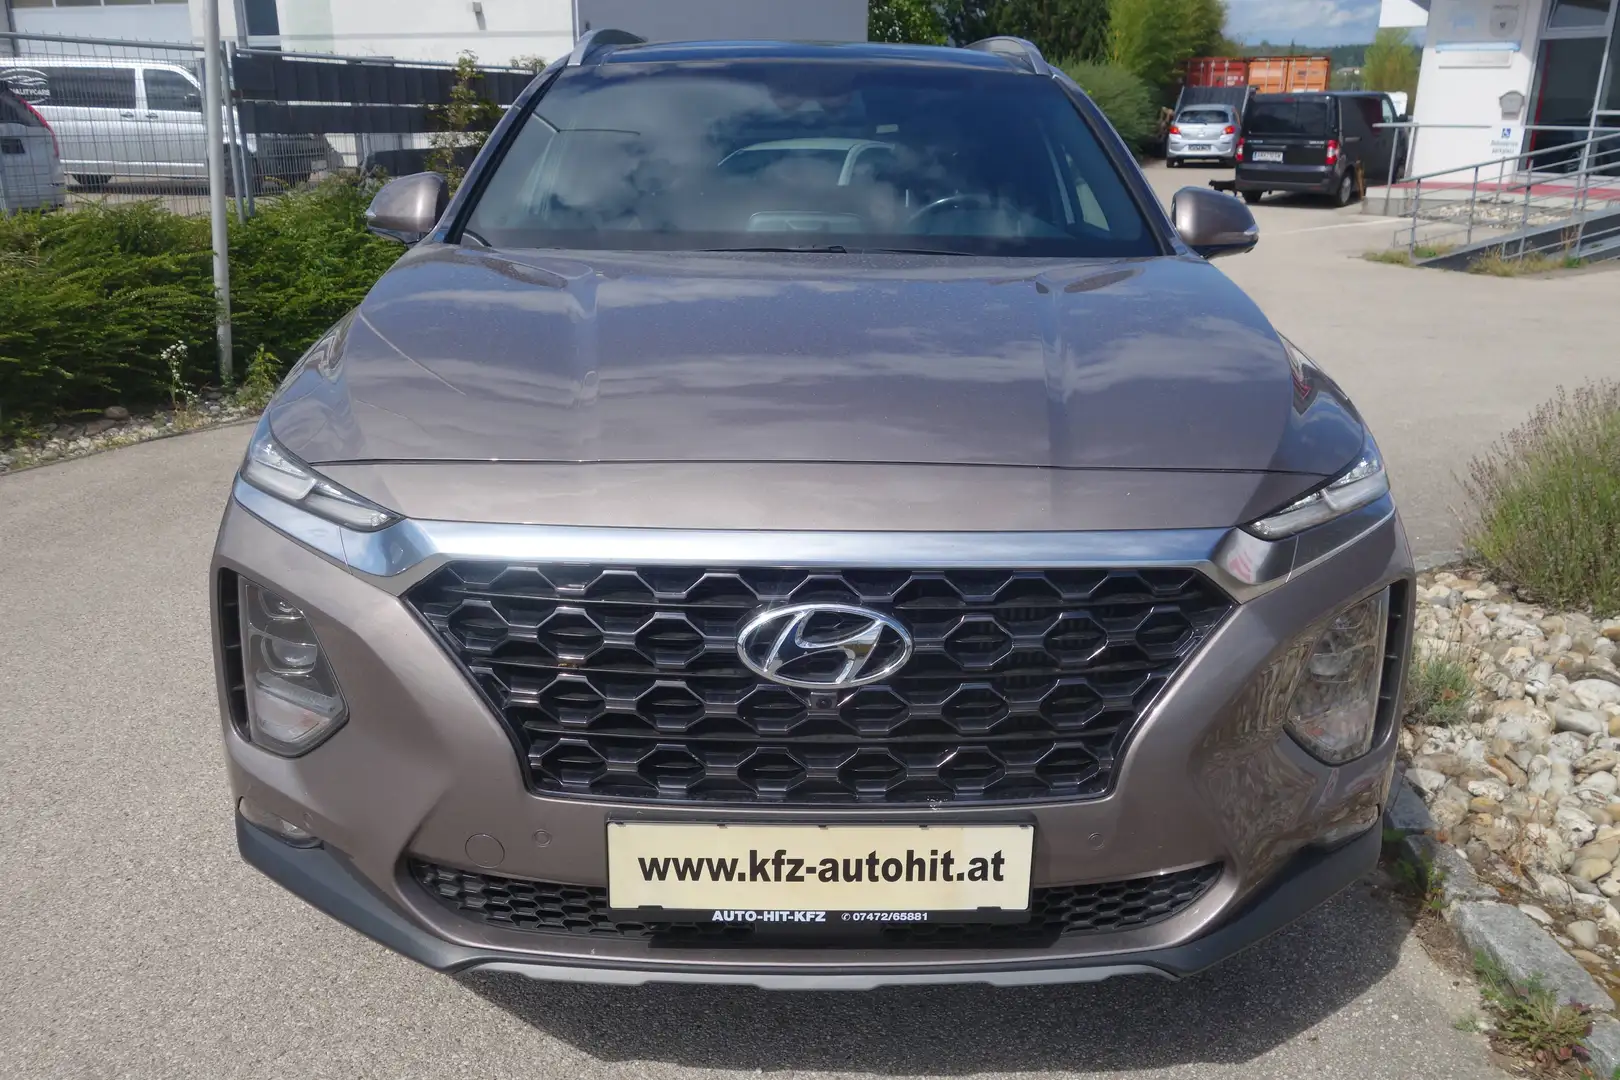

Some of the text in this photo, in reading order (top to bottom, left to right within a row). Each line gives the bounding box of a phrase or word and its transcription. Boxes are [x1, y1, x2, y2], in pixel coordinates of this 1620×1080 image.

[638, 849, 1005, 883] www.kfz-autohit.at
[711, 910, 928, 922] AUTO-HIT-KFZ 07472/65881
